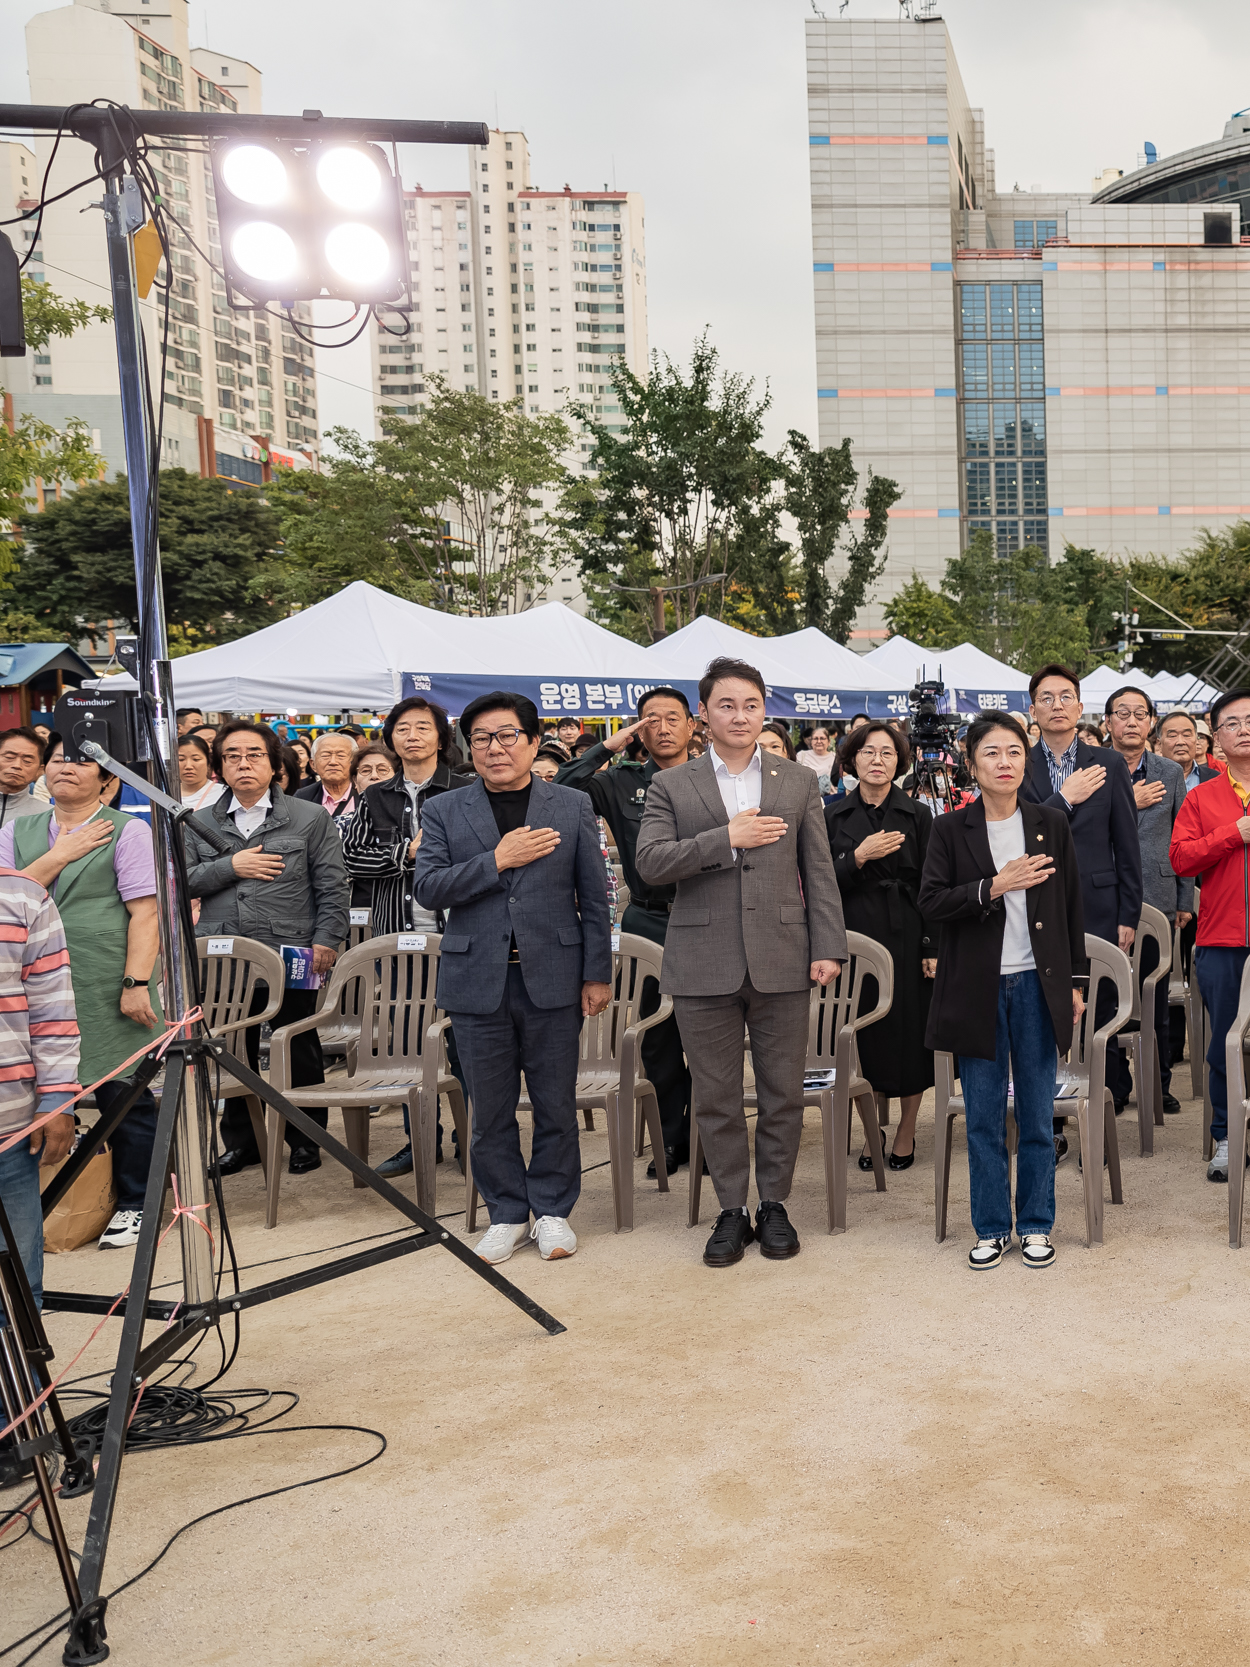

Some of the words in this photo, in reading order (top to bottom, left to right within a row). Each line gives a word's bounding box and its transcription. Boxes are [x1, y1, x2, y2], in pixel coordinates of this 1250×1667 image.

[539, 683, 581, 710] 운영
[585, 683, 625, 710] 본부
[793, 692, 842, 714] 응급부스
[978, 694, 1008, 710] 타로카드
